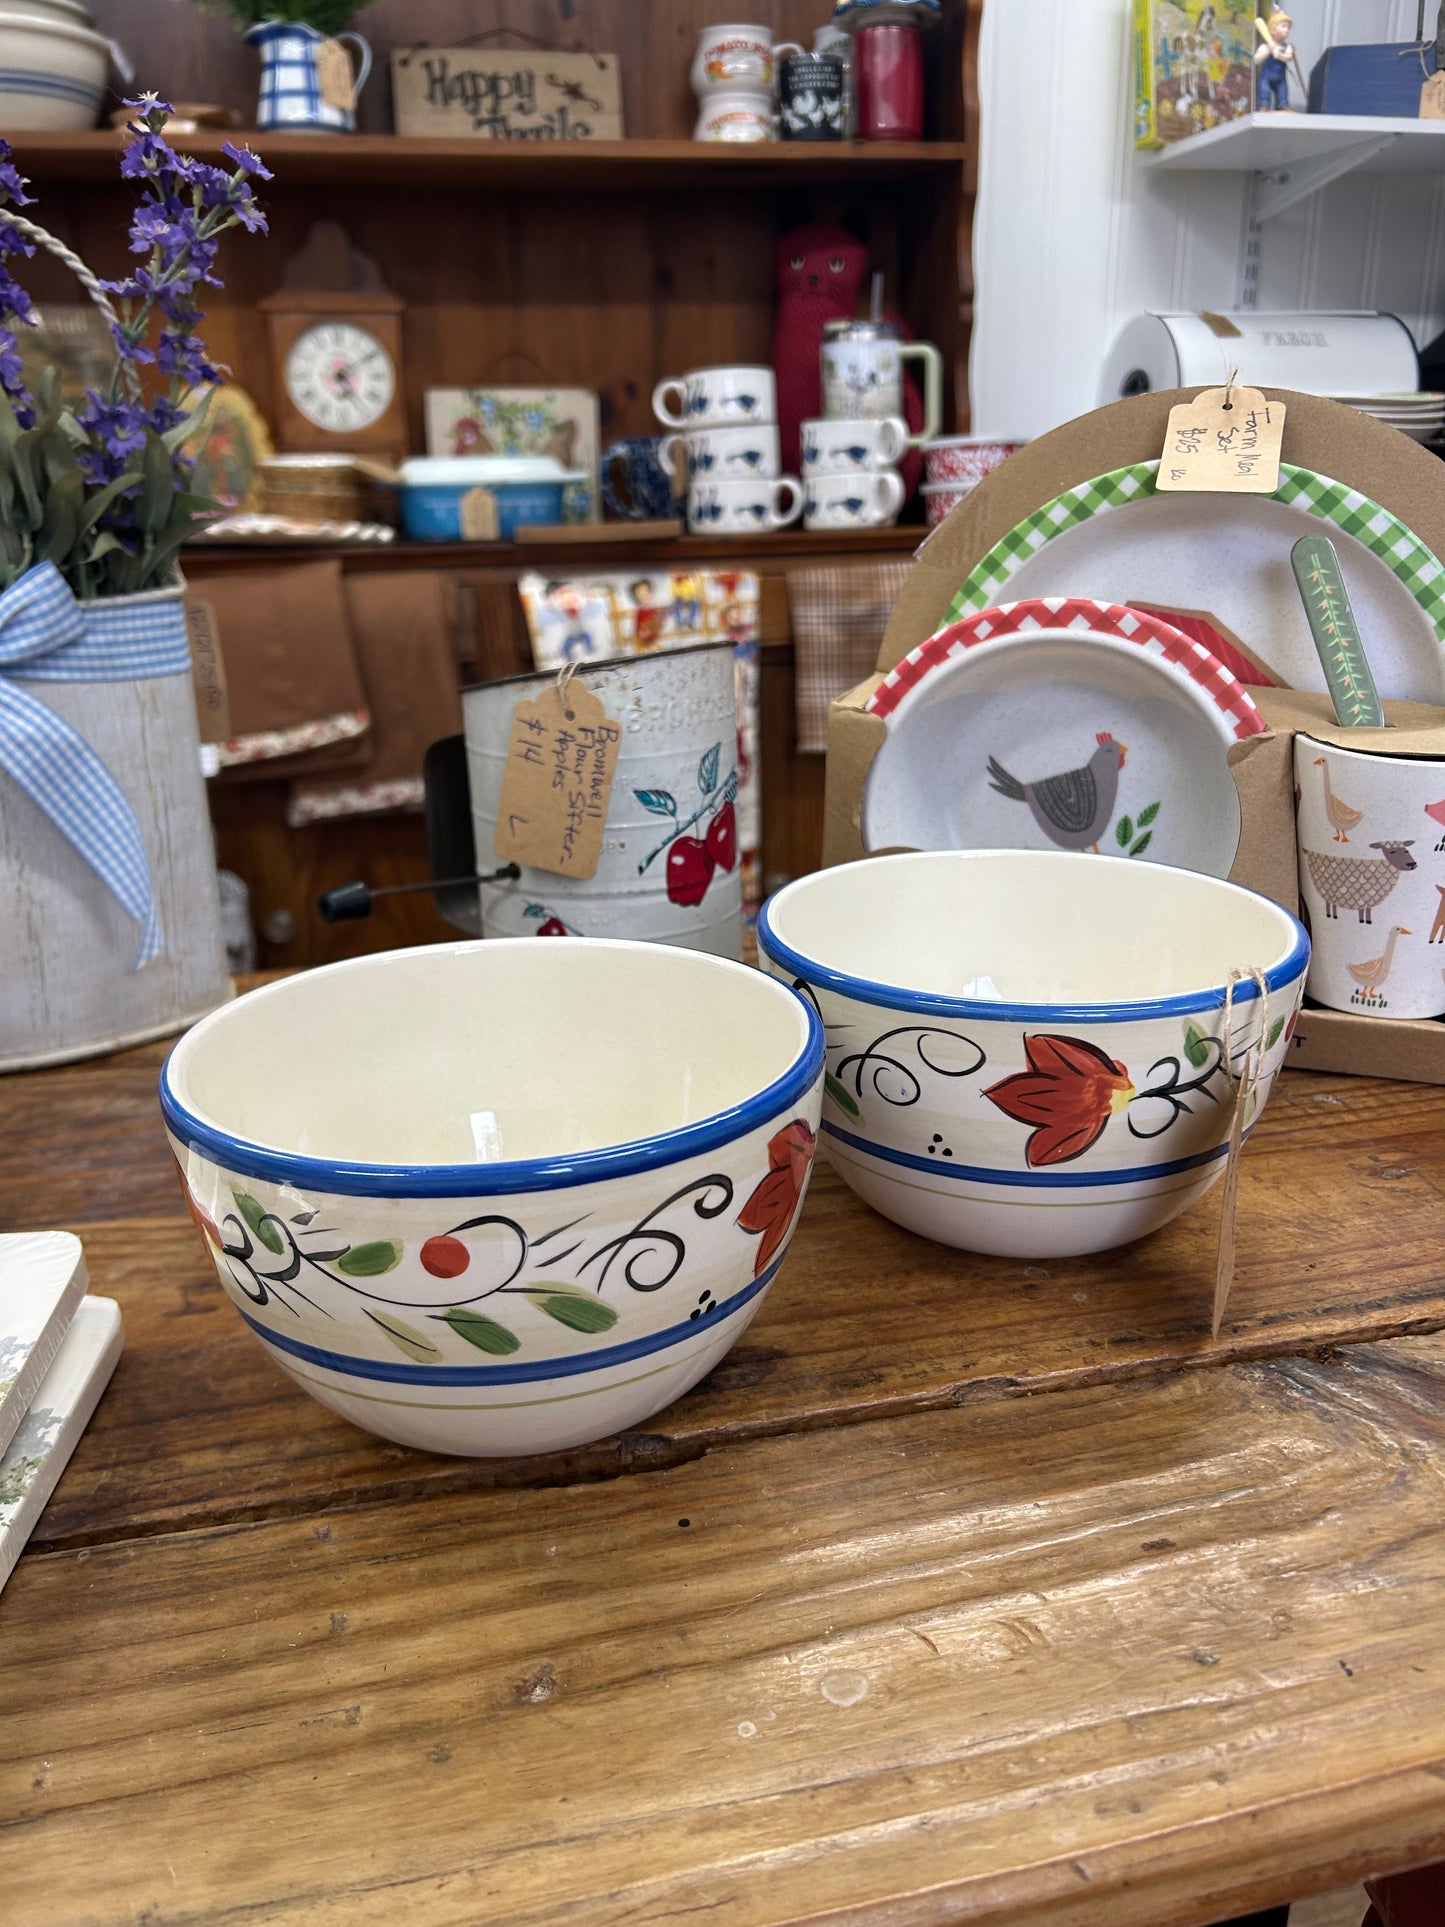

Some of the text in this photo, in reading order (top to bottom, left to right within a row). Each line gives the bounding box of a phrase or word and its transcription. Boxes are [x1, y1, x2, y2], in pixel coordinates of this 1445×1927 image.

[421, 57, 536, 116] Happy
[1175, 428, 1208, 453] $25
[1217, 426, 1240, 453] Set
[1240, 407, 1271, 450] Farm
[552, 728, 576, 791] Apples
[573, 726, 595, 785] Flour
[586, 725, 619, 818] Bromwell
